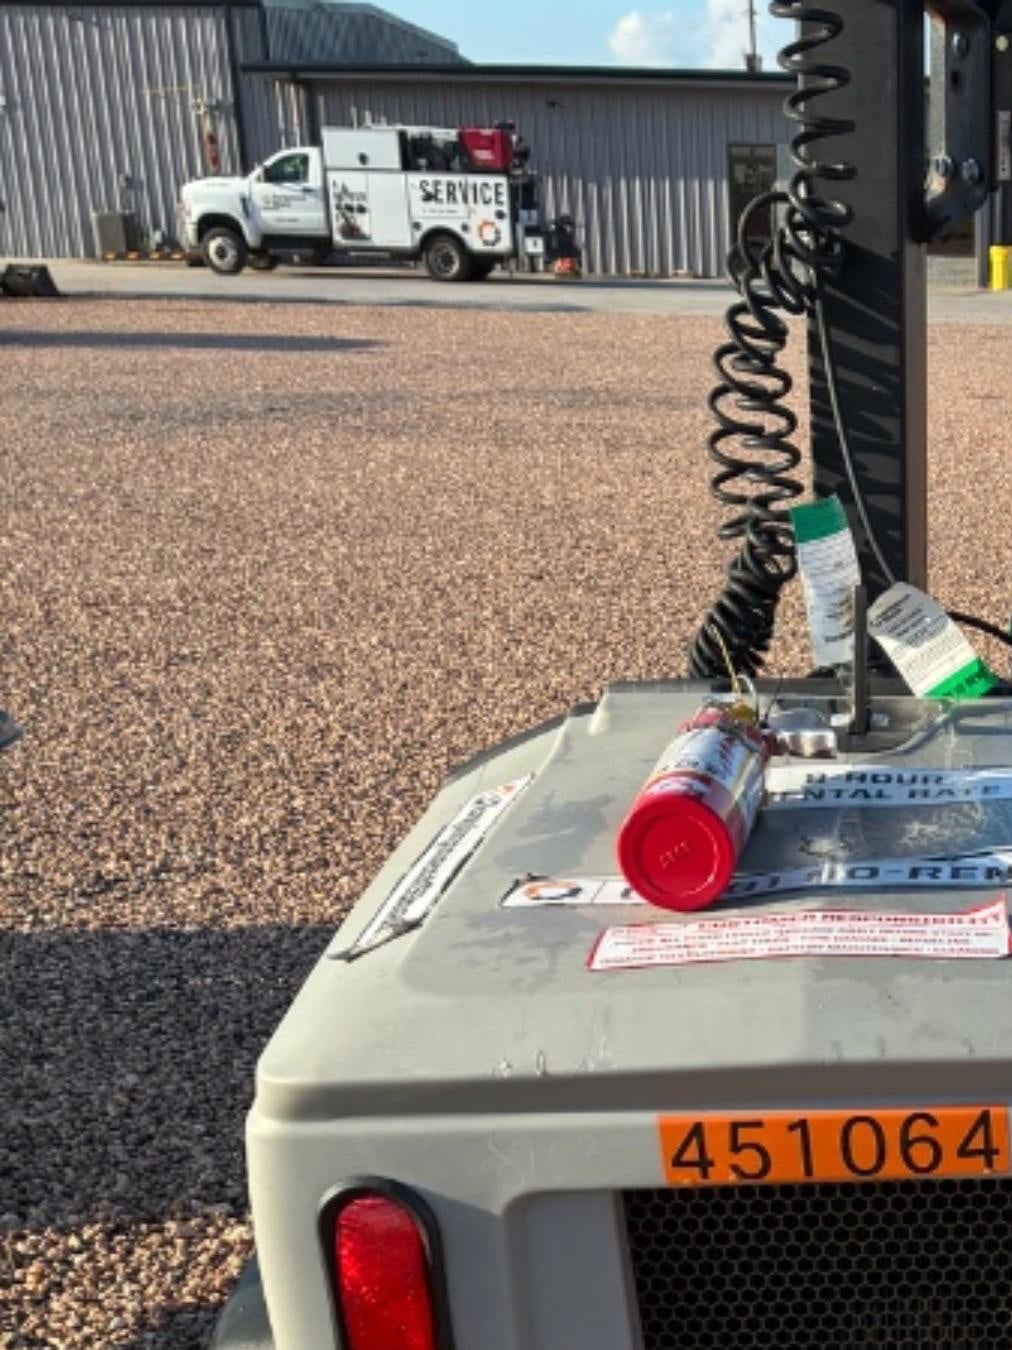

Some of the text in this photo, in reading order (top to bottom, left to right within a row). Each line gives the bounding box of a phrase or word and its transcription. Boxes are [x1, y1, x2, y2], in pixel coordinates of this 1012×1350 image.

[419, 178, 505, 206] SERVICE
[766, 786, 893, 802] ENTAL
[671, 1108, 1001, 1180] 451064
